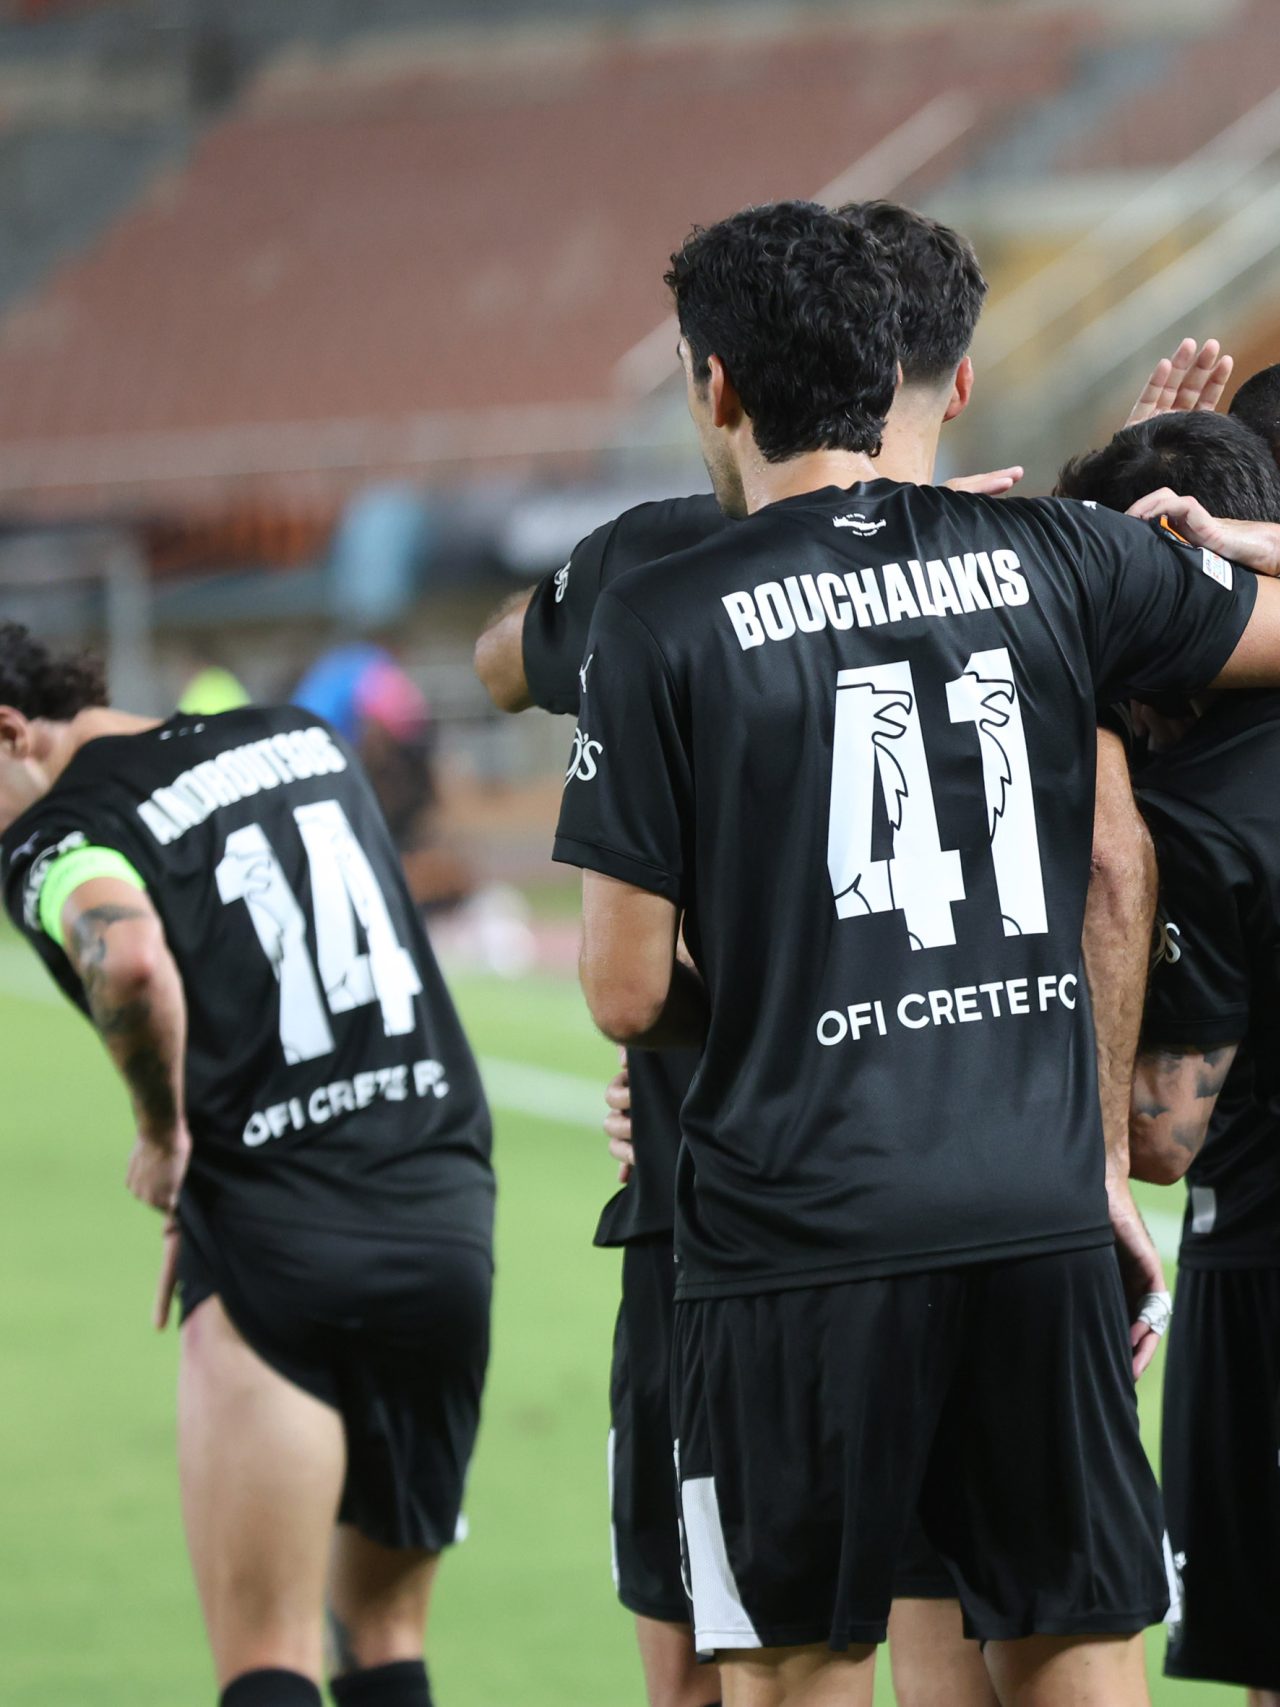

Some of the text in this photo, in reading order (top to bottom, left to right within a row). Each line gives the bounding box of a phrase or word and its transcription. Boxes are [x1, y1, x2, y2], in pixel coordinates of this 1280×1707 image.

[721, 549, 1031, 651] BOUCHALAKIS
[827, 647, 1050, 951] 41
[214, 799, 423, 1066] 14
[816, 973, 1079, 1046] OFI CRETE FC
[242, 1096, 306, 1148] OFI
